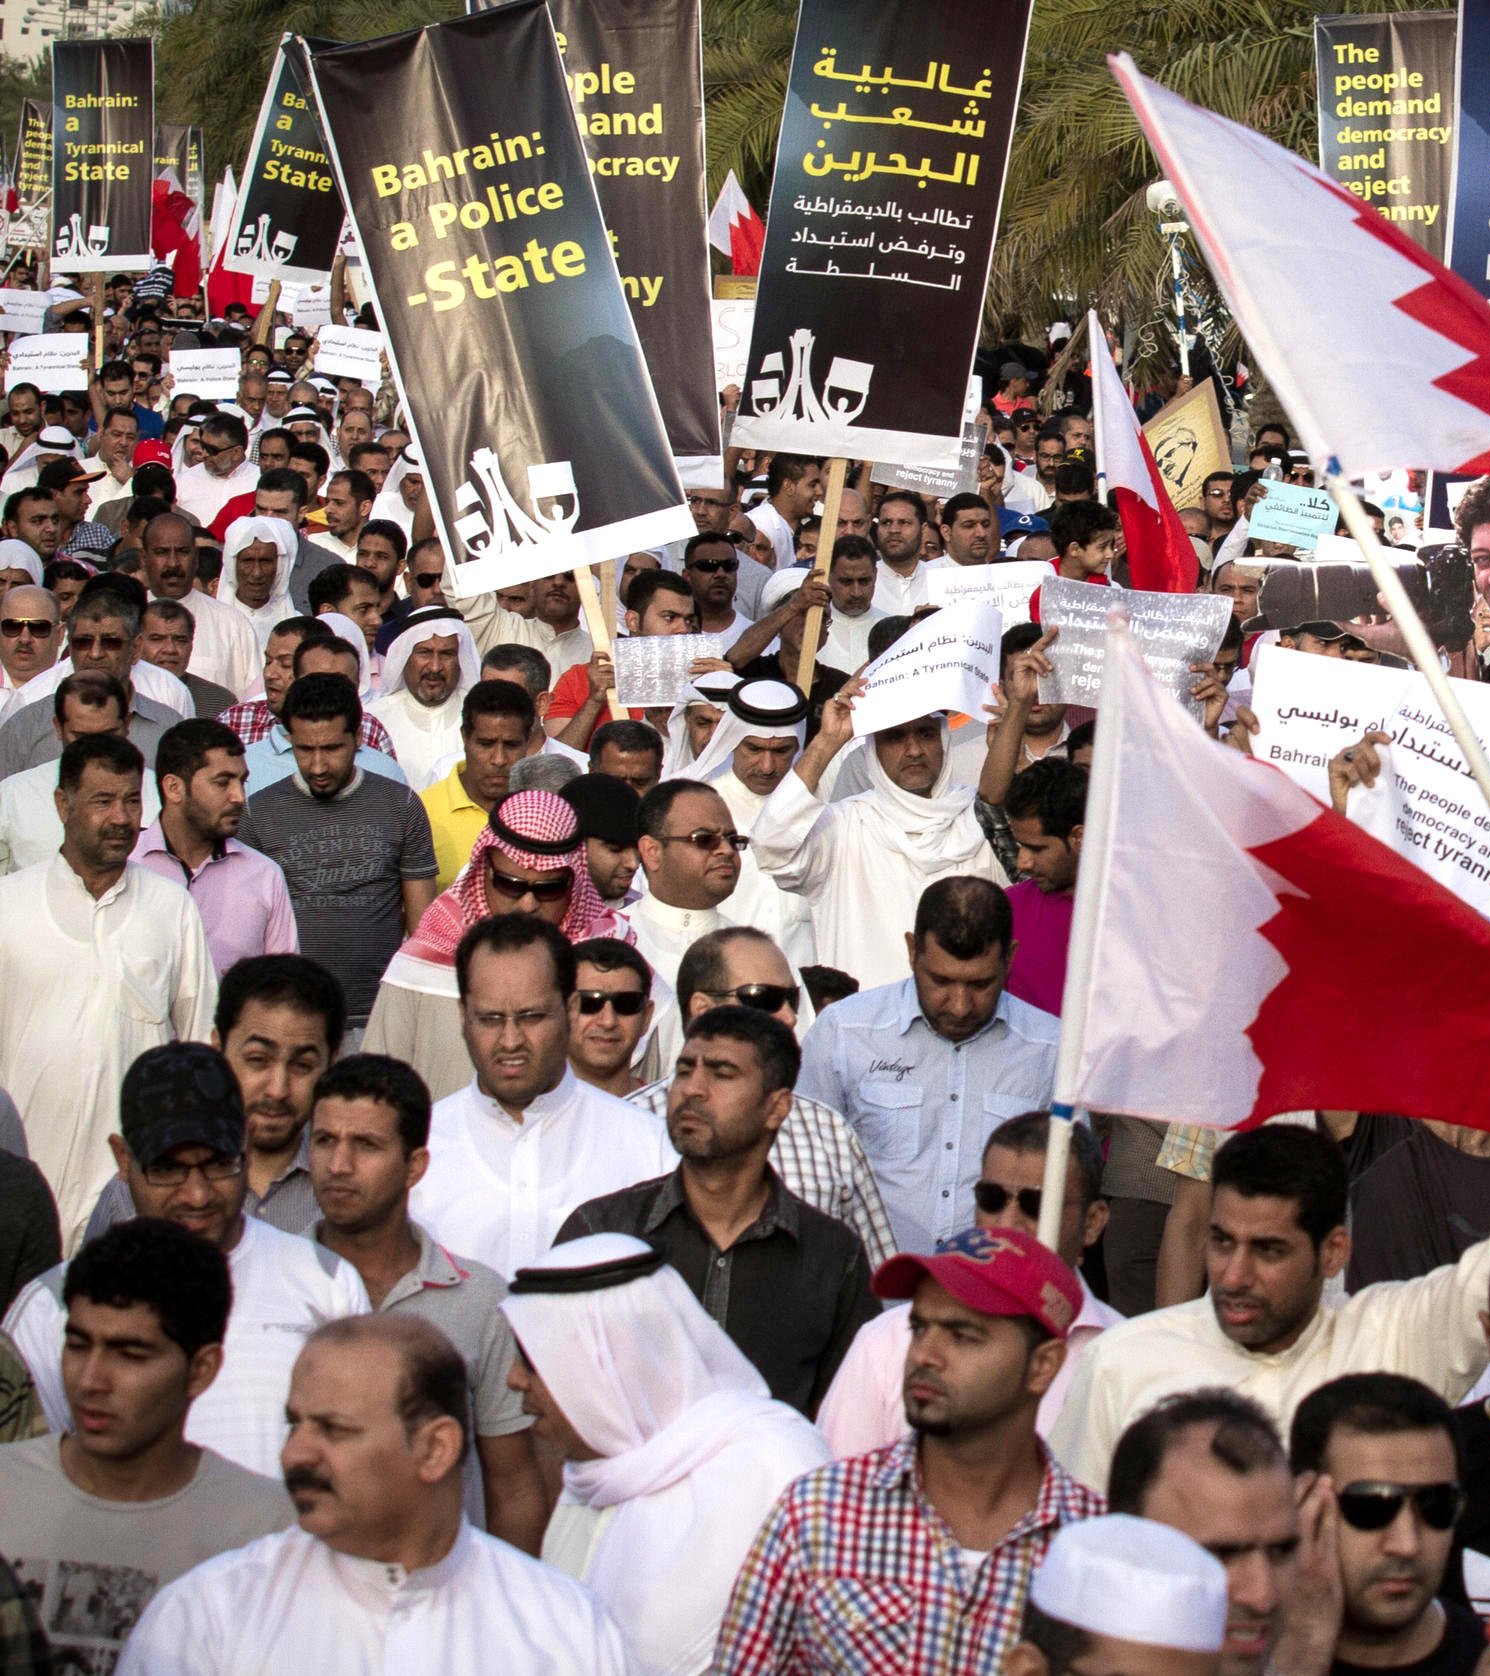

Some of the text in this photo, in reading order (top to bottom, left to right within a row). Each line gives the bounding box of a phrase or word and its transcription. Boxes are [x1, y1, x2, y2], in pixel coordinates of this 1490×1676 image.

[1333, 43, 1379, 64] The
[813, 47, 993, 99] غالبية
[1335, 67, 1424, 96] people
[65, 93, 138, 109] Bahrain:
[1336, 93, 1441, 118] demand
[65, 116, 79, 132] a
[276, 114, 293, 131] a
[810, 100, 986, 138] شعب
[24, 140, 53, 151] dema
[26, 130, 53, 143] peop
[1336, 126, 1451, 144] democracy
[65, 141, 144, 158] Tyrannical
[1338, 148, 1385, 170] and
[21, 161, 41, 170] and
[65, 161, 130, 181] State
[371, 131, 546, 198] Bahrain:
[802, 139, 980, 189] البحرين
[262, 159, 333, 192] State
[390, 220, 419, 251] a
[428, 182, 565, 239] Police
[793, 195, 974, 230] تطالب بالديمقراطية
[1374, 204, 1440, 226] anny
[791, 227, 966, 264] وترفض استبداد
[785, 257, 962, 292] السلطة
[896, 468, 959, 490] reject tyranny
[912, 668, 920, 677] A
[1071, 675, 1100, 692] reje
[1277, 704, 1360, 733] بوليسي
[1270, 745, 1332, 769] Bahrai
[1394, 774, 1418, 797] The
[1417, 789, 1471, 820] people
